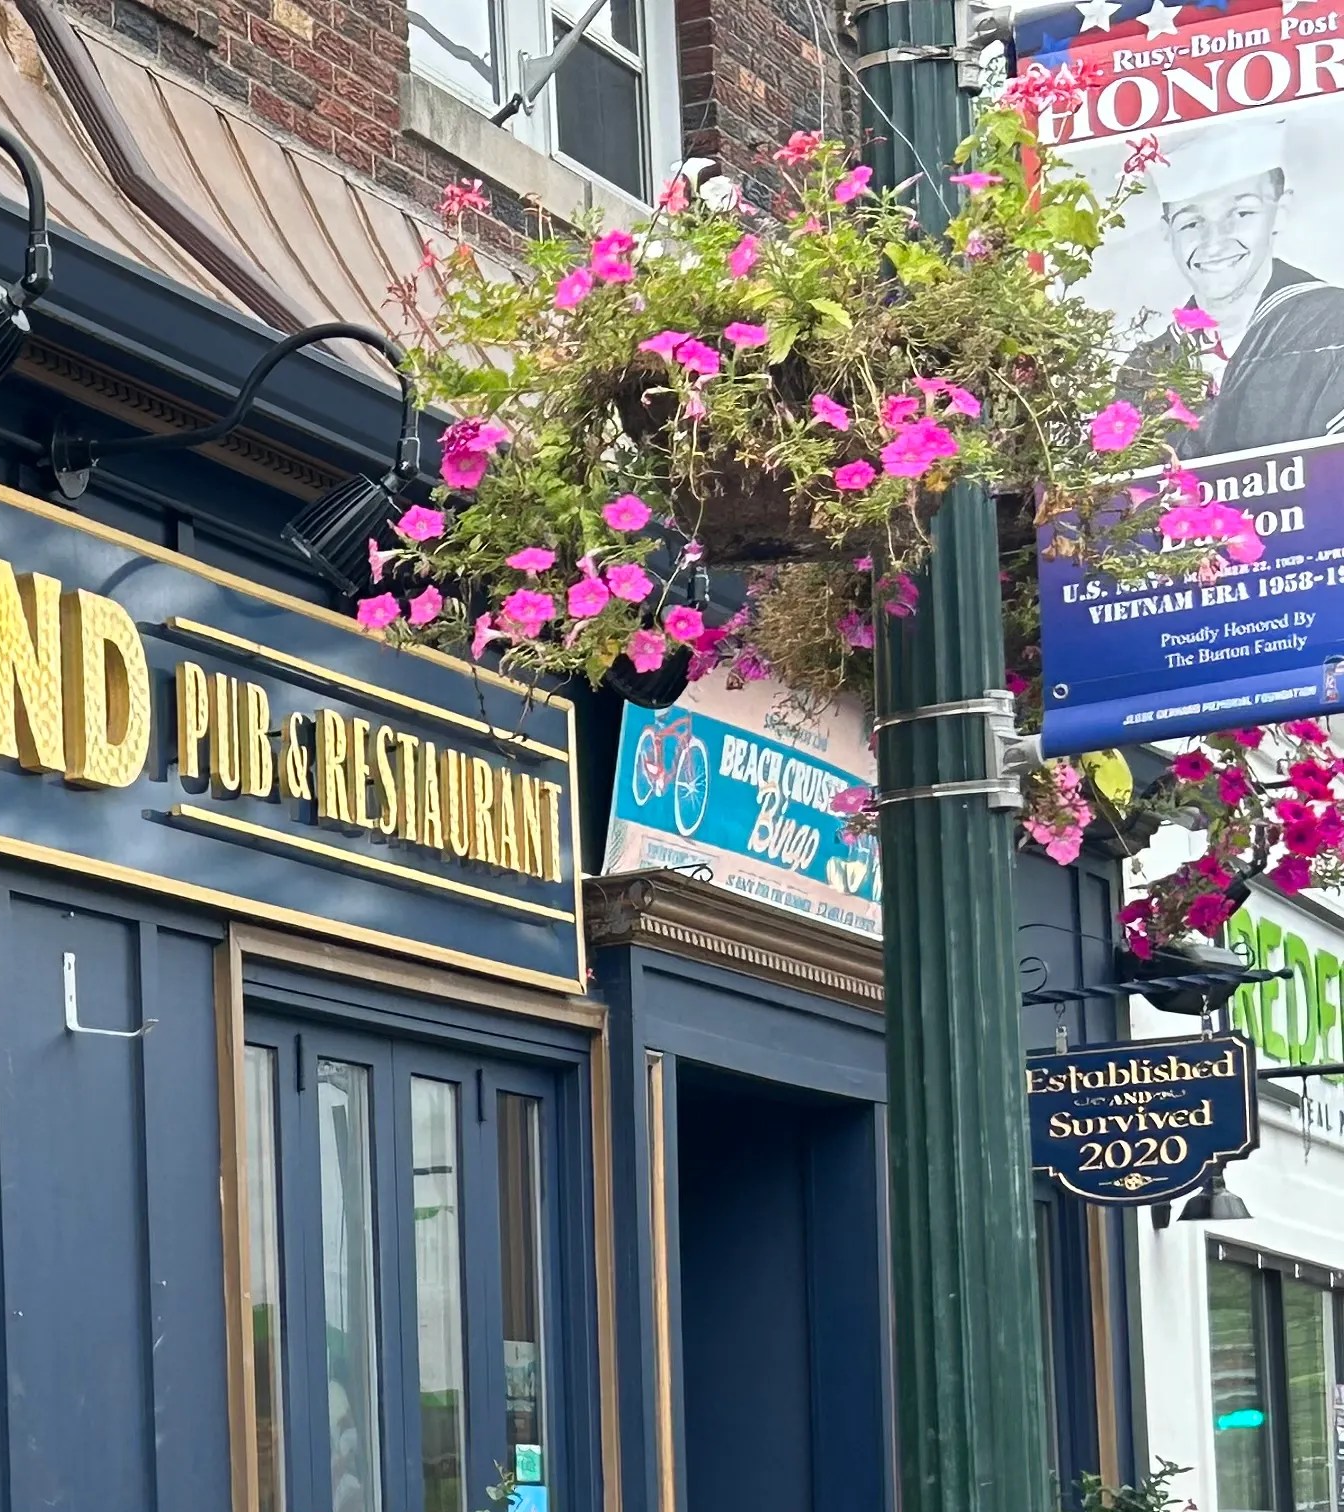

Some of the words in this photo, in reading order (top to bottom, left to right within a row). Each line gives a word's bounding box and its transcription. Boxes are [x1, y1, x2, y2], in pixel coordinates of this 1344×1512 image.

[1113, 28, 1270, 73] Rusy-Bohm
[1280, 13, 1339, 40] Post
[1158, 456, 1306, 511] onald
[1062, 580, 1108, 604] U.S.
[1089, 589, 1193, 624] VIETNAM
[1201, 581, 1250, 607] ERA
[1160, 626, 1220, 649] Proudly
[1223, 613, 1290, 638] Honored
[1293, 611, 1317, 628] By
[1164, 652, 1195, 669] The
[1254, 633, 1309, 656] Family
[176, 661, 274, 798] PUB
[280, 711, 312, 801] &
[316, 708, 563, 885] RESTAURANT
[718, 734, 783, 794] BEACH
[747, 784, 820, 871] Bingo
[1025, 1050, 1237, 1095] Established
[1048, 1099, 1214, 1139] Survived
[1108, 1090, 1153, 1107] AND
[1079, 1135, 1189, 1172] 2020
